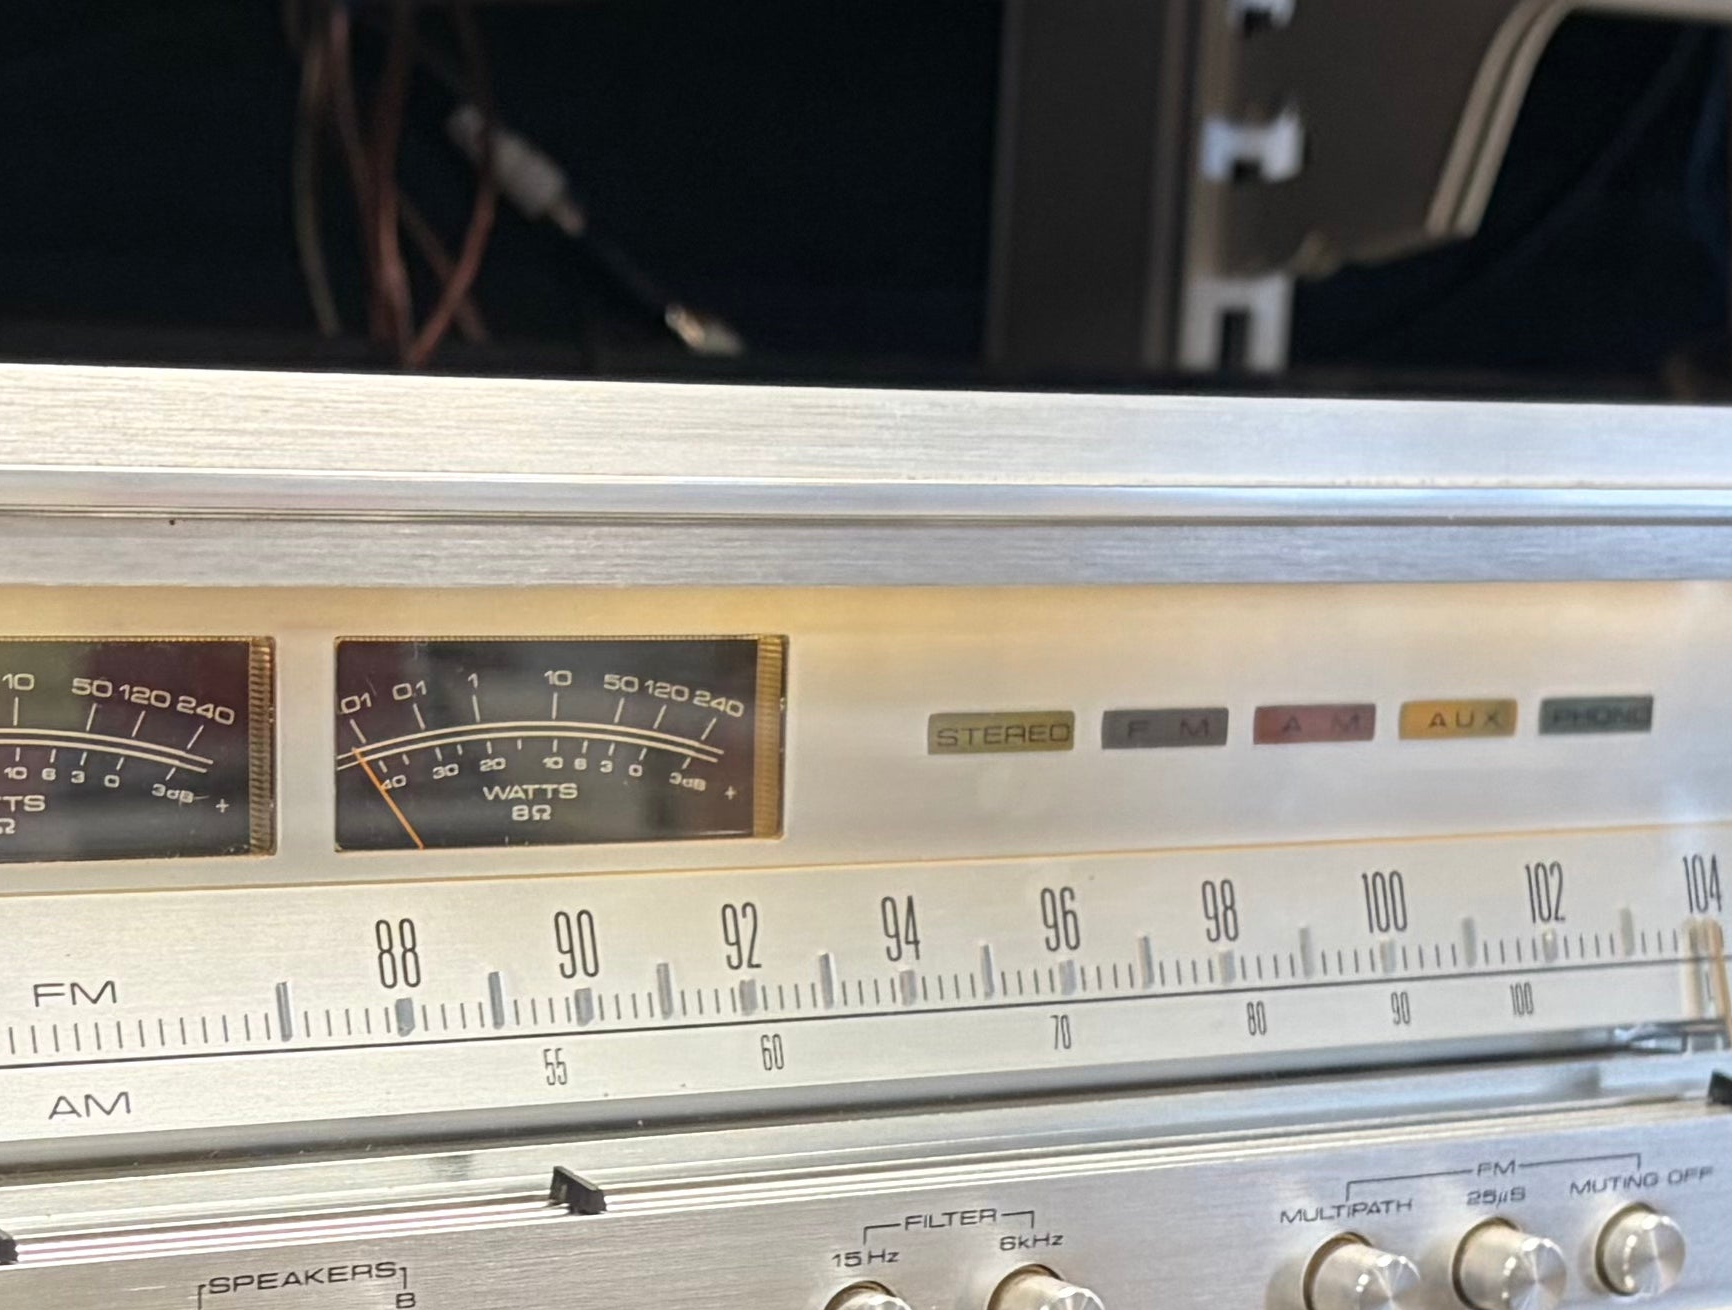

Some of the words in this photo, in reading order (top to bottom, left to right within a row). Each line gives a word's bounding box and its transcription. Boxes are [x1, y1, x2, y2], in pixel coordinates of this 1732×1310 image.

[3, 673, 35, 691] 10
[71, 677, 113, 698] 50
[119, 684, 171, 709] 120
[176, 695, 235, 726] 240
[466, 673, 478, 688] 1
[544, 669, 572, 686] 10
[603, 674, 638, 693] 50
[644, 680, 689, 703] 120
[693, 690, 744, 718] 240
[936, 723, 1070, 747] STEREO
[1428, 709, 1502, 728] AUX
[4, 766, 28, 780] 10
[42, 768, 57, 782] 6
[71, 770, 86, 784] 3
[104, 774, 121, 789] 0
[151, 783, 195, 804] 3dB
[381, 774, 406, 790] 40
[432, 763, 459, 779] 30
[479, 757, 506, 771] 20
[542, 757, 564, 770] 10
[600, 760, 614, 773] 3
[629, 764, 643, 778] 0
[669, 772, 706, 791] 3dB
[483, 783, 578, 800] WATTS
[511, 804, 551, 821] 8Ω
[33, 980, 118, 1007] FM
[375, 917, 422, 989] 88
[553, 909, 600, 979] 90
[721, 902, 762, 971] 92
[880, 895, 921, 962] 94
[1040, 886, 1081, 952] 96
[1201, 879, 1239, 943] 98
[1361, 870, 1408, 934] 100
[1524, 861, 1566, 924] 102
[1682, 853, 1723, 914] 104
[48, 1091, 132, 1120] AM
[543, 1047, 569, 1086] 55
[760, 1033, 785, 1071] 60
[1050, 1014, 1073, 1050] 70
[1246, 1001, 1267, 1037] 80
[1390, 991, 1411, 1026] 90
[1509, 981, 1534, 1017] 100
[1476, 1160, 1517, 1179] FM
[1569, 1172, 1660, 1196] MUTING
[1667, 1166, 1714, 1185] OFF
[904, 1208, 998, 1231] FILTER
[1280, 1198, 1415, 1225] MULTIPATH
[999, 1233, 1064, 1252] 6kHz
[209, 1261, 398, 1296] SPEAKERS
[395, 1292, 417, 1309] B
